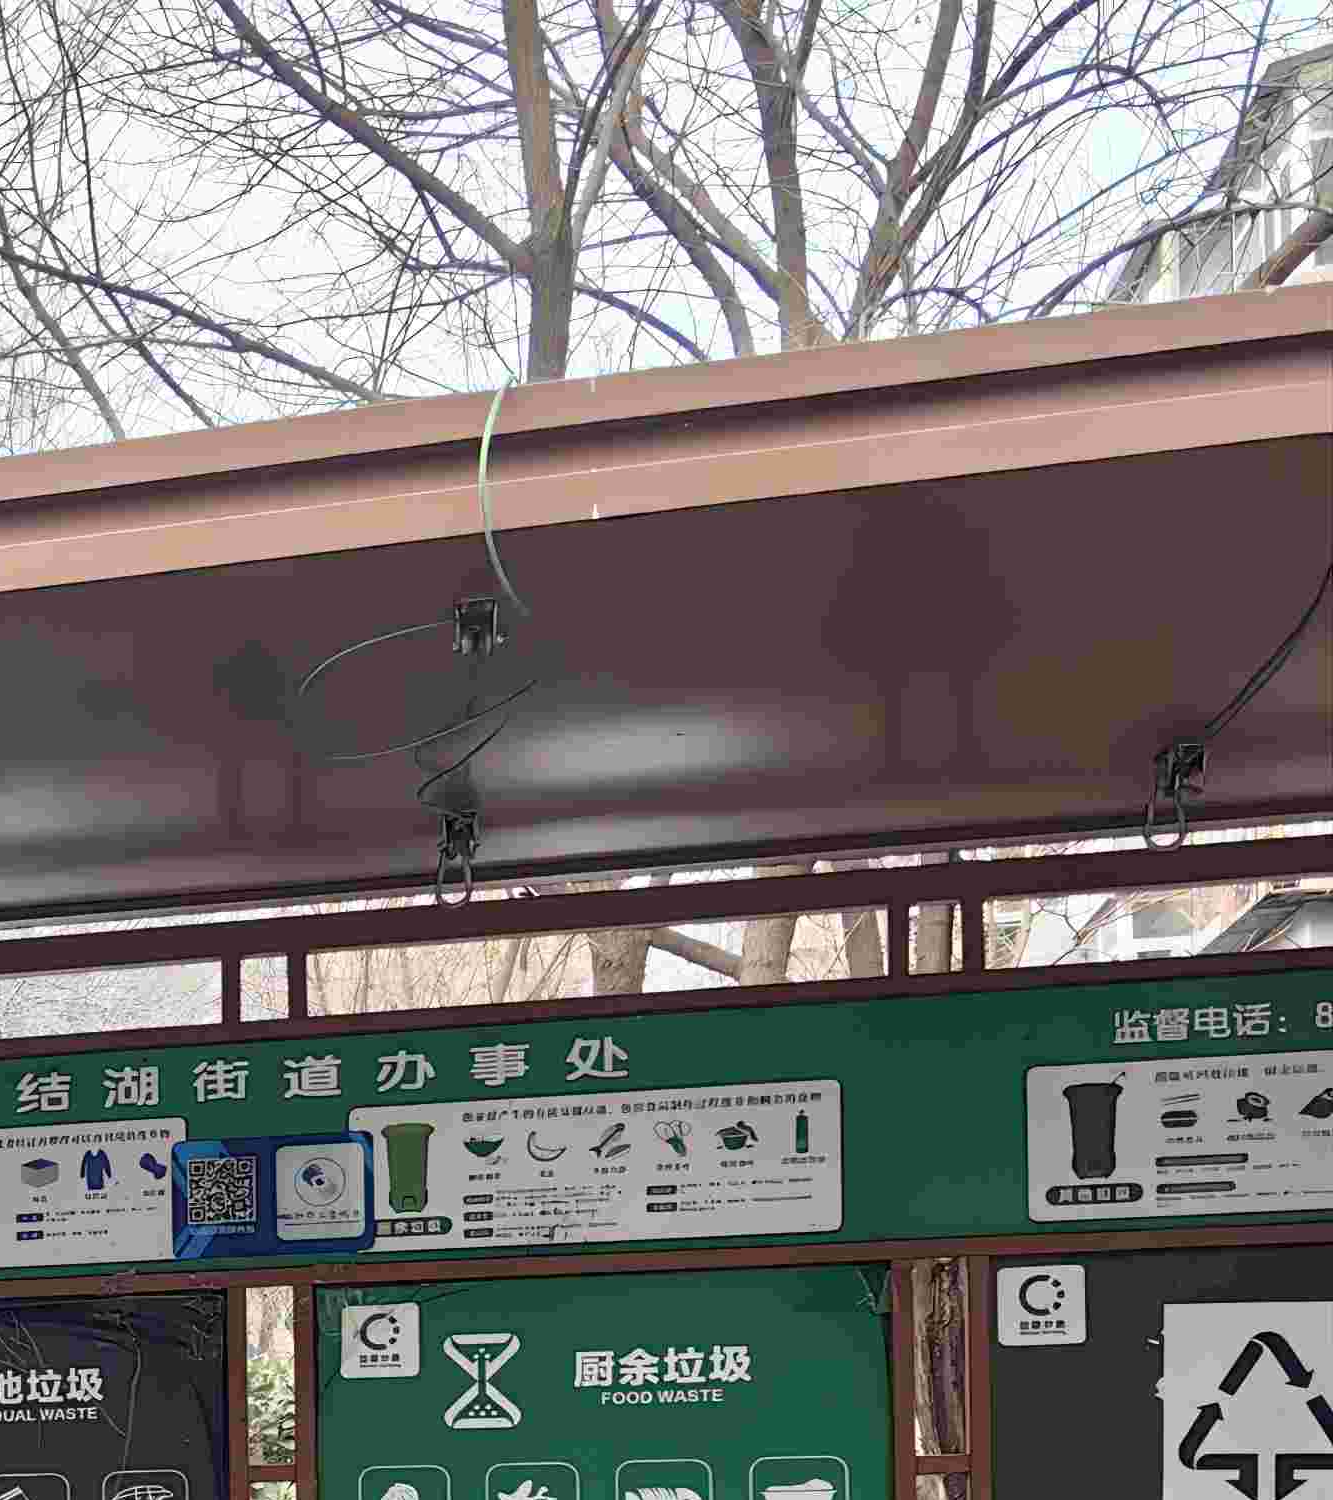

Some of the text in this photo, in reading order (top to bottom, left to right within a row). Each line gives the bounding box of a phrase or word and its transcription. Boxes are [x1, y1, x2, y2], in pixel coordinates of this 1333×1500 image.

[1113, 1003, 1287, 1045] 监督电话：
[574, 1345, 752, 1388] 厨余垃圾
[601, 1388, 724, 1405] FOOD WASTE
[39, 1406, 98, 1422] WASTE
